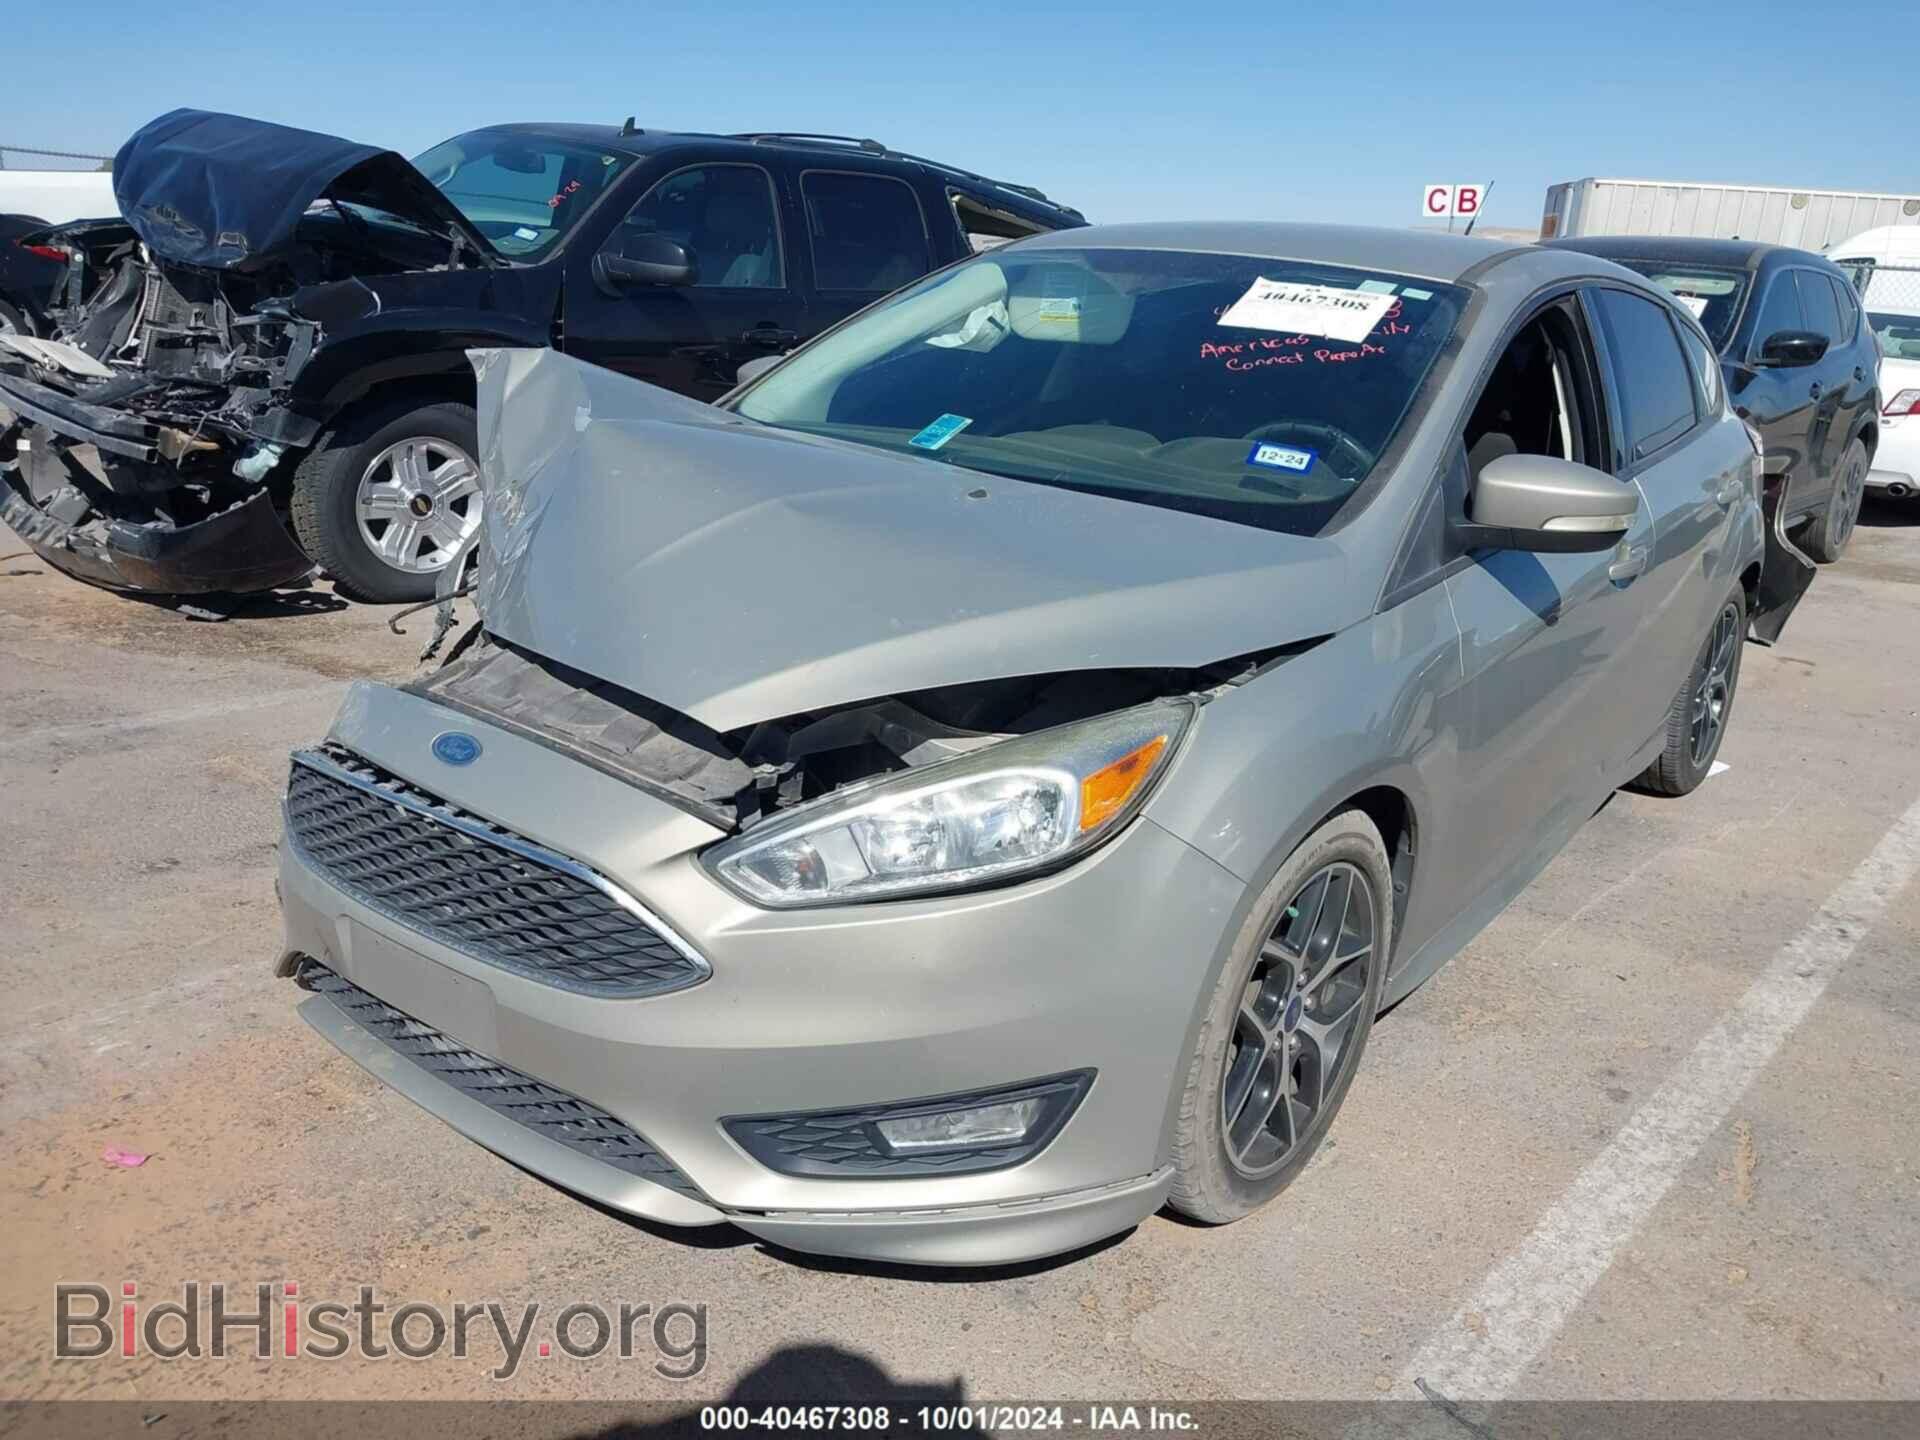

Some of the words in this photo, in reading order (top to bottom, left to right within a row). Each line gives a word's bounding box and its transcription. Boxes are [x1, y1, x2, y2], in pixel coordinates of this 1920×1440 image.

[1428, 188, 1447, 213] C
[1458, 188, 1477, 213] B
[1258, 291, 1371, 311] 40467308
